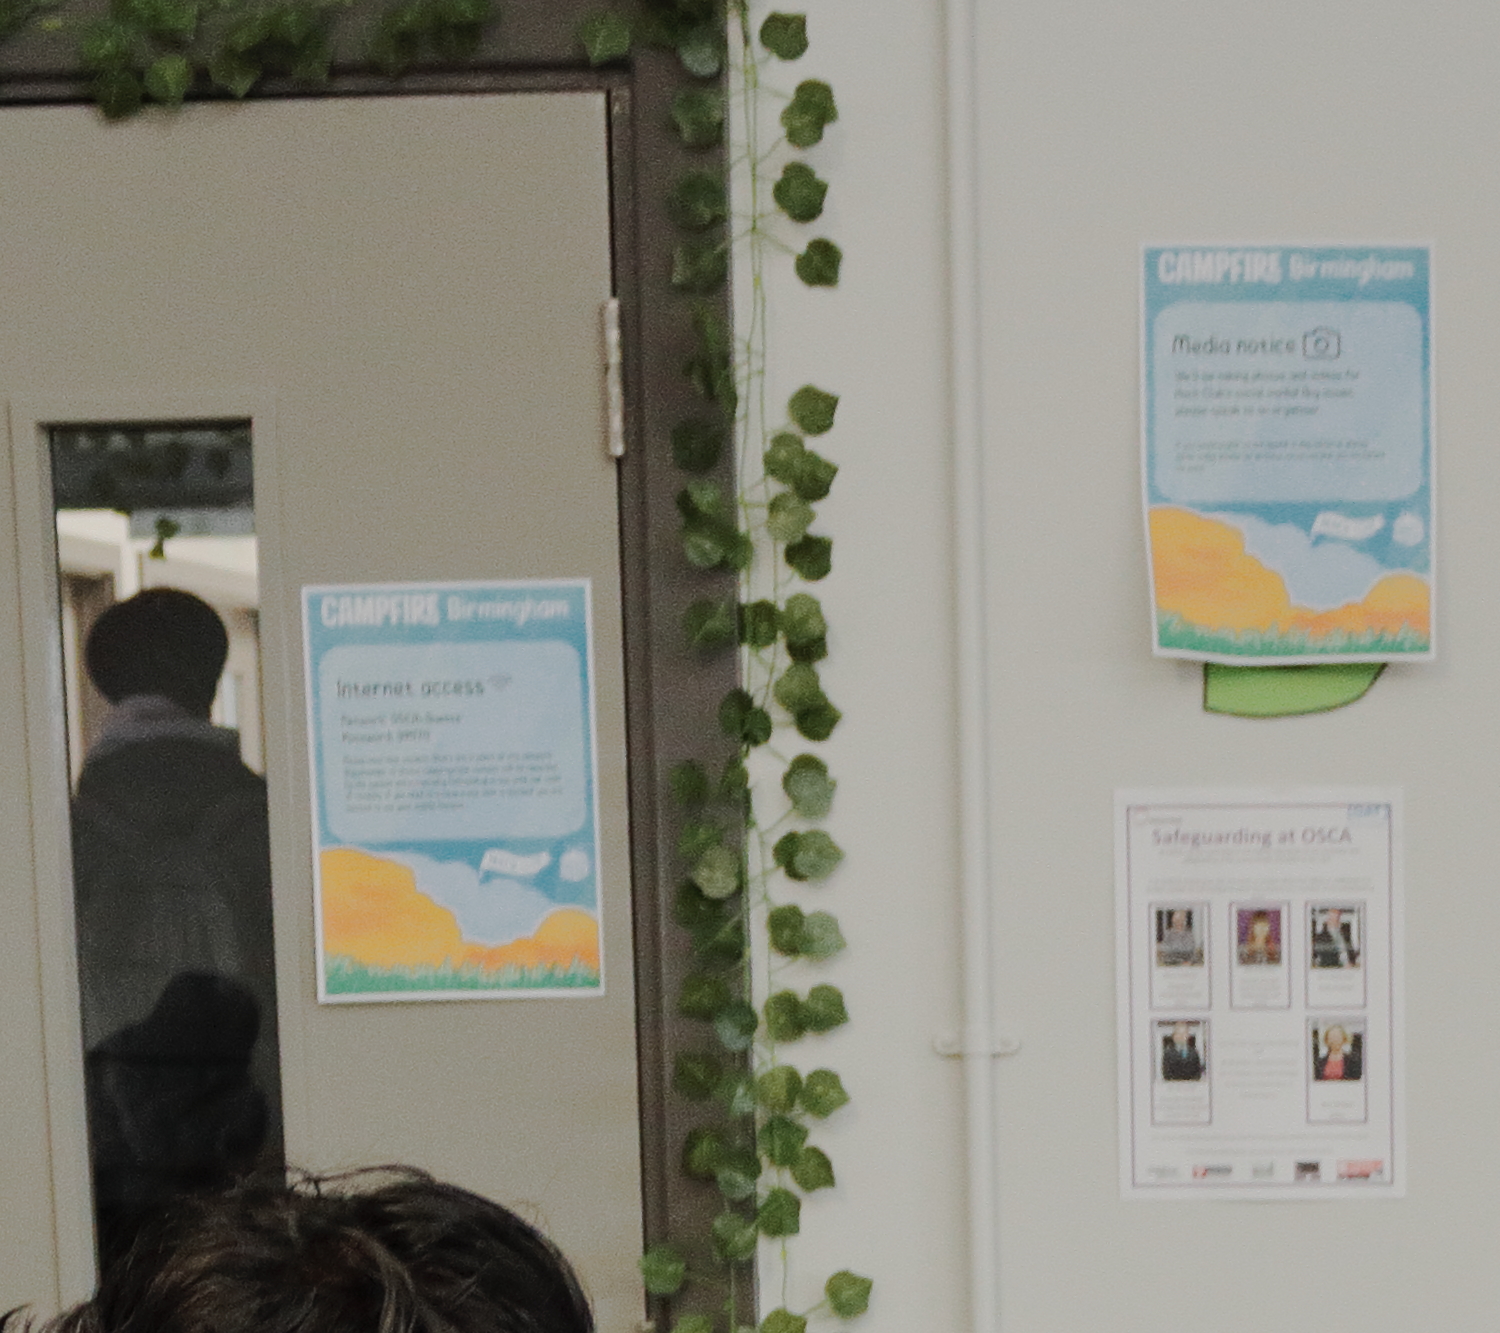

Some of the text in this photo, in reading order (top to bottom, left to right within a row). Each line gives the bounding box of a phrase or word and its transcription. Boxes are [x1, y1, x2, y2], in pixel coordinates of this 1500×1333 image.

[1158, 250, 1415, 287] CAMPFIRE Birmingham
[1171, 333, 1296, 354] Media notice
[320, 593, 571, 627] CAMPFIRE Birmingham
[336, 678, 485, 698] Internet access
[1151, 826, 1353, 848] Safeguarding at OSCA
